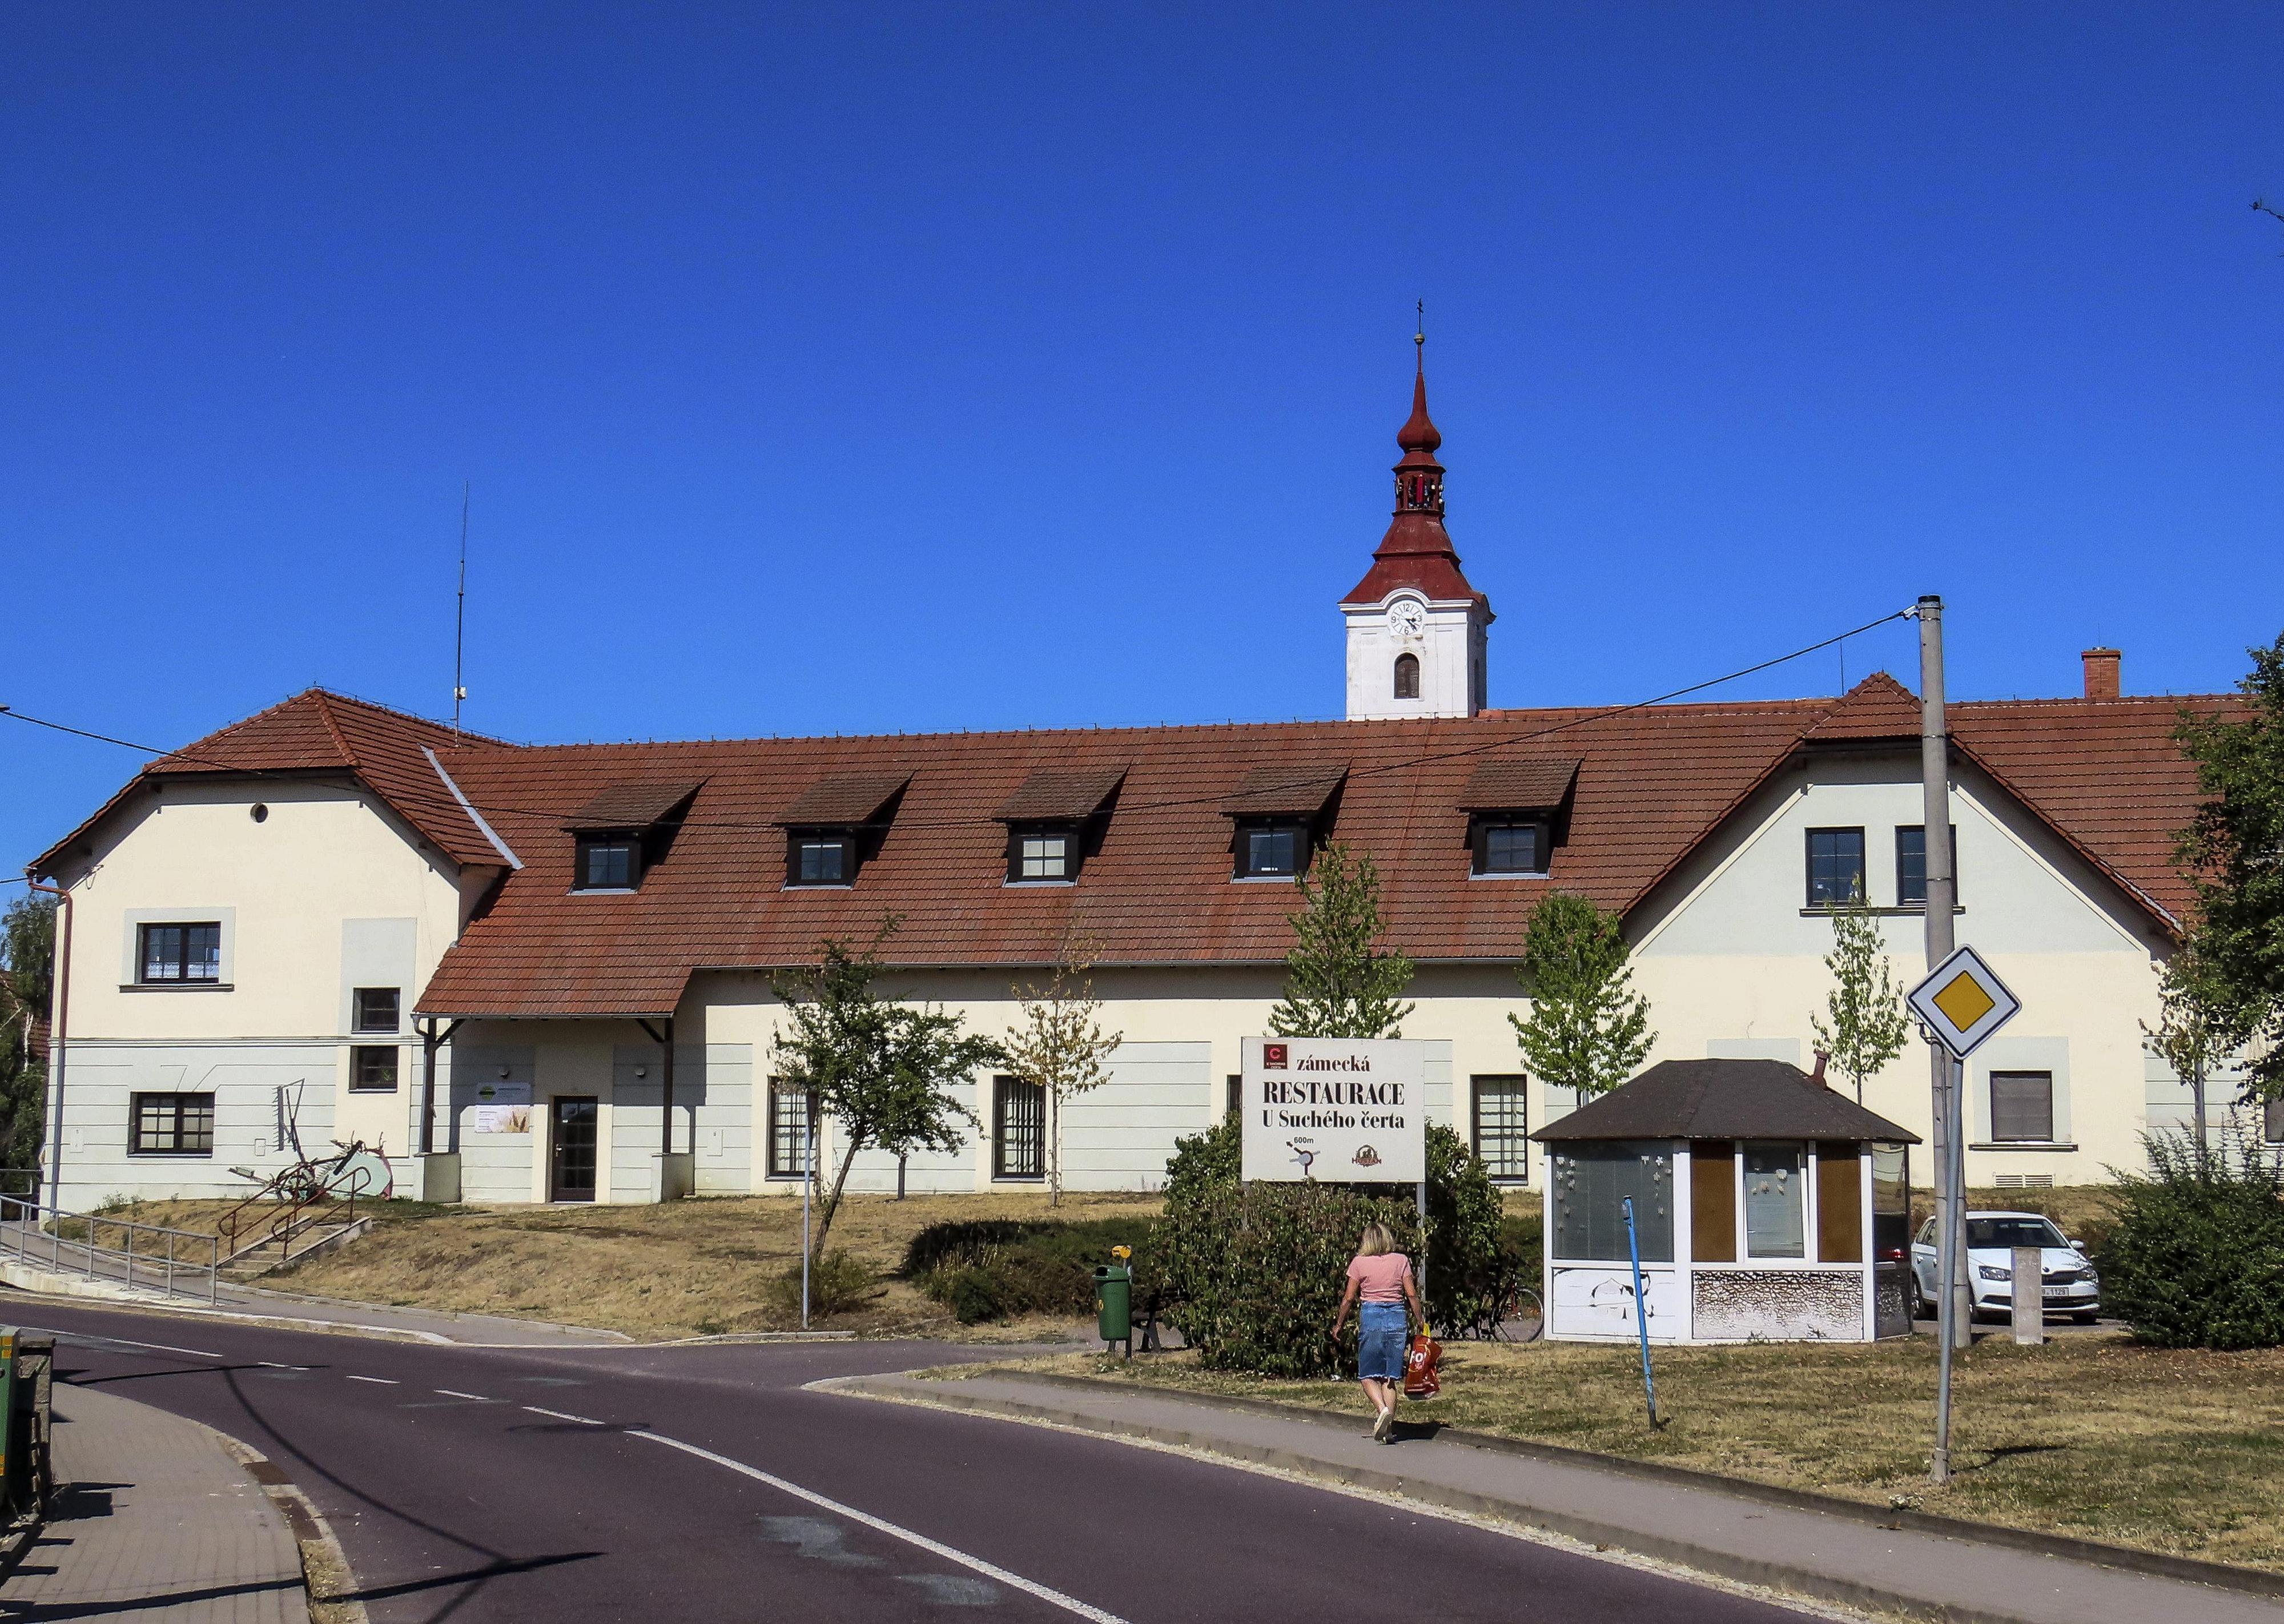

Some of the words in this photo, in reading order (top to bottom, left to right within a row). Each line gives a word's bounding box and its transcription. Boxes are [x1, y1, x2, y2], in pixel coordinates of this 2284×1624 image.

[1404, 626, 1409, 635] 6
[1297, 1054, 1371, 1072] zámecká
[1262, 1081, 1405, 1106] RESTAURACE
[1262, 1110, 1274, 1128] U
[1278, 1110, 1356, 1128] Suchého
[1361, 1110, 1405, 1129] čerta
